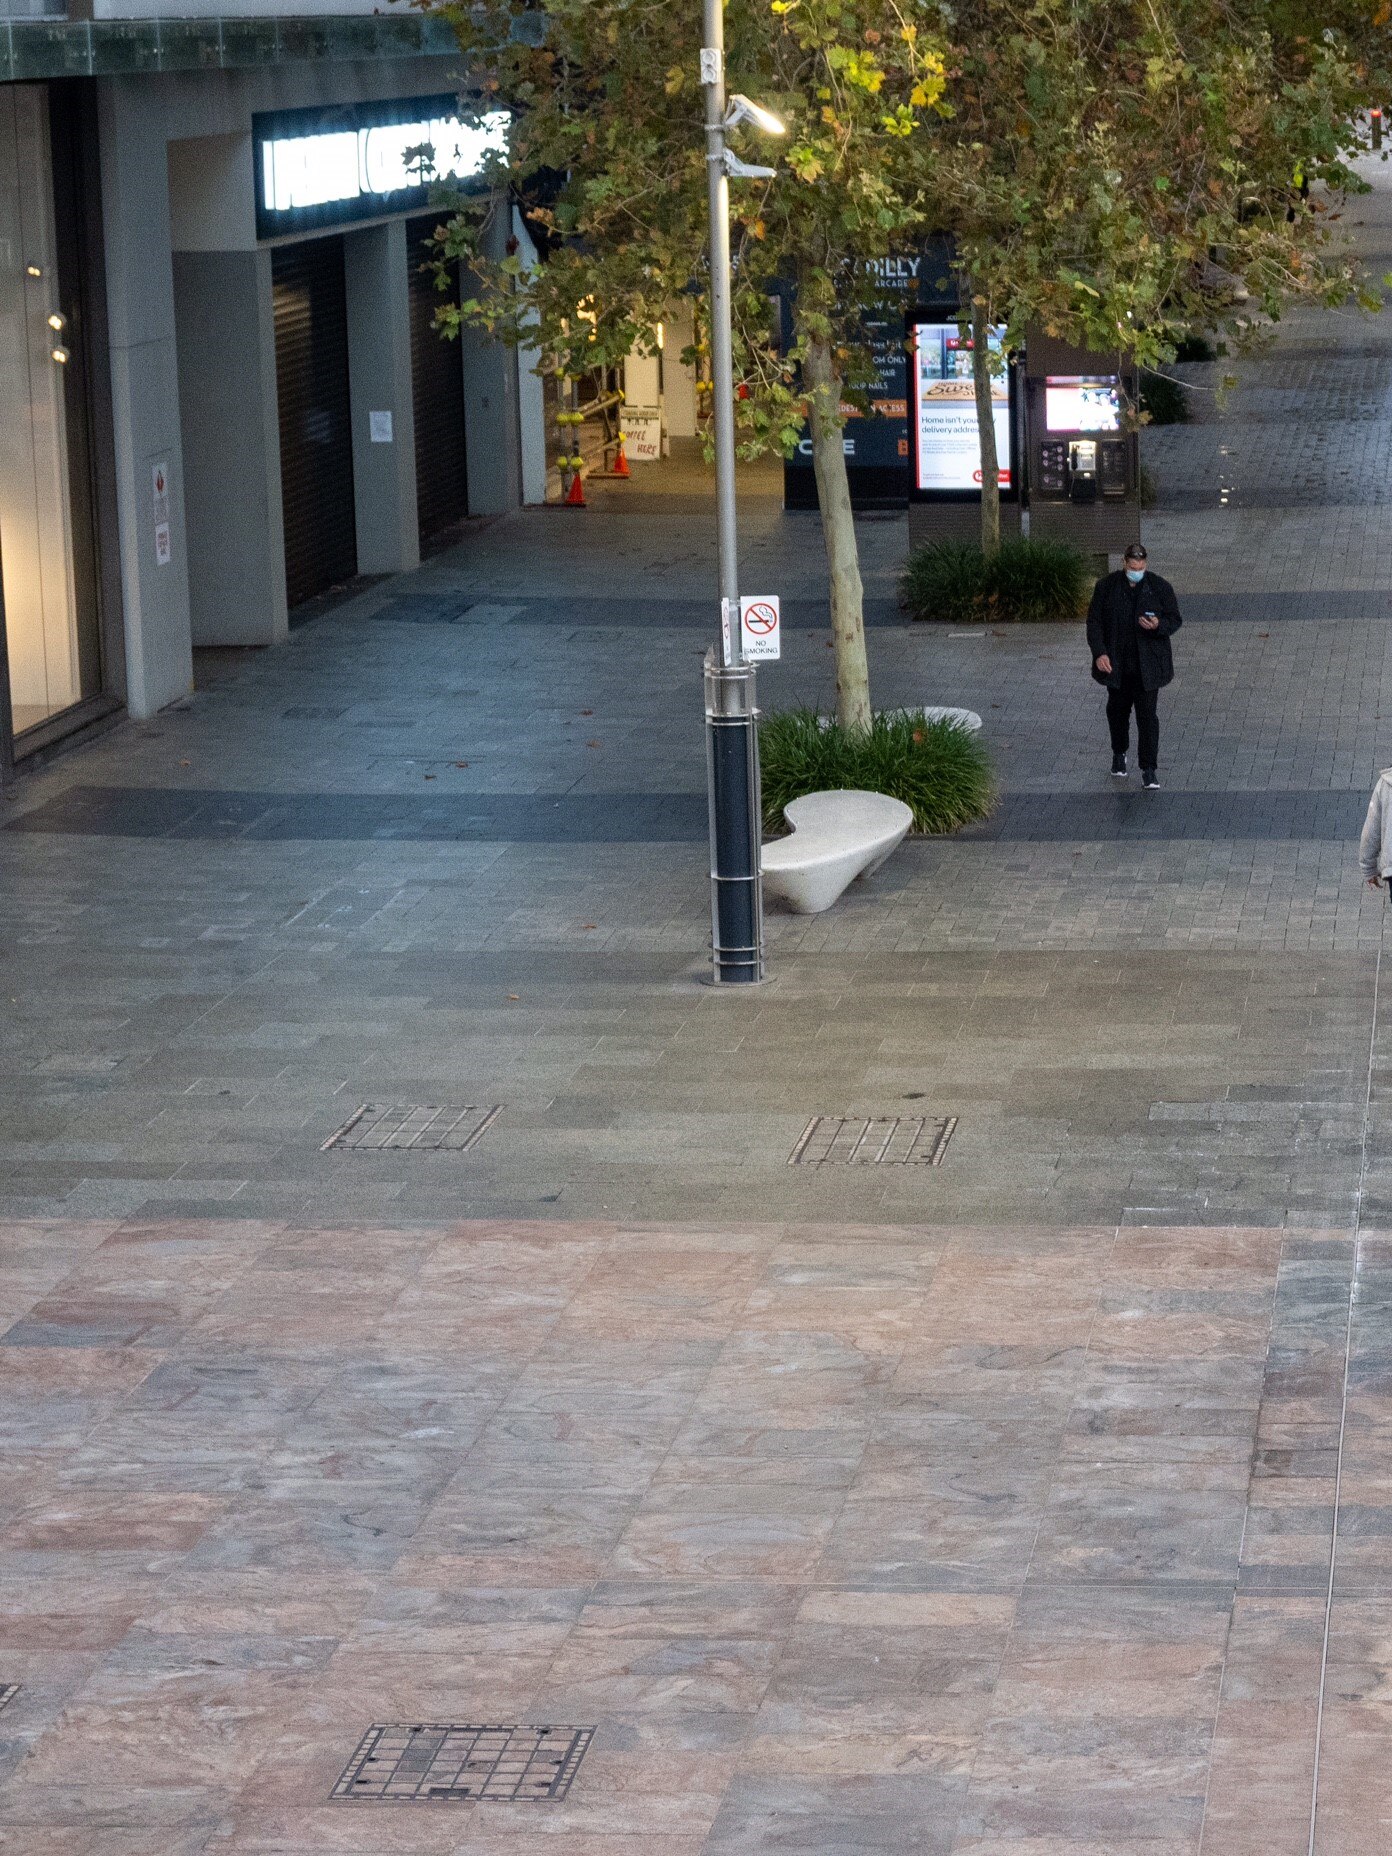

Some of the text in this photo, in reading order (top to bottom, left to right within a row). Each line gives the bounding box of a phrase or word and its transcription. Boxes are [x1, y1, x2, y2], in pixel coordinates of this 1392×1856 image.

[874, 279, 907, 288] ARCADE
[887, 356, 906, 364] ONLY
[868, 382, 888, 390] NAILS
[921, 416, 945, 424] Home
[945, 416, 962, 424] isn't
[921, 425, 952, 434] delivery
